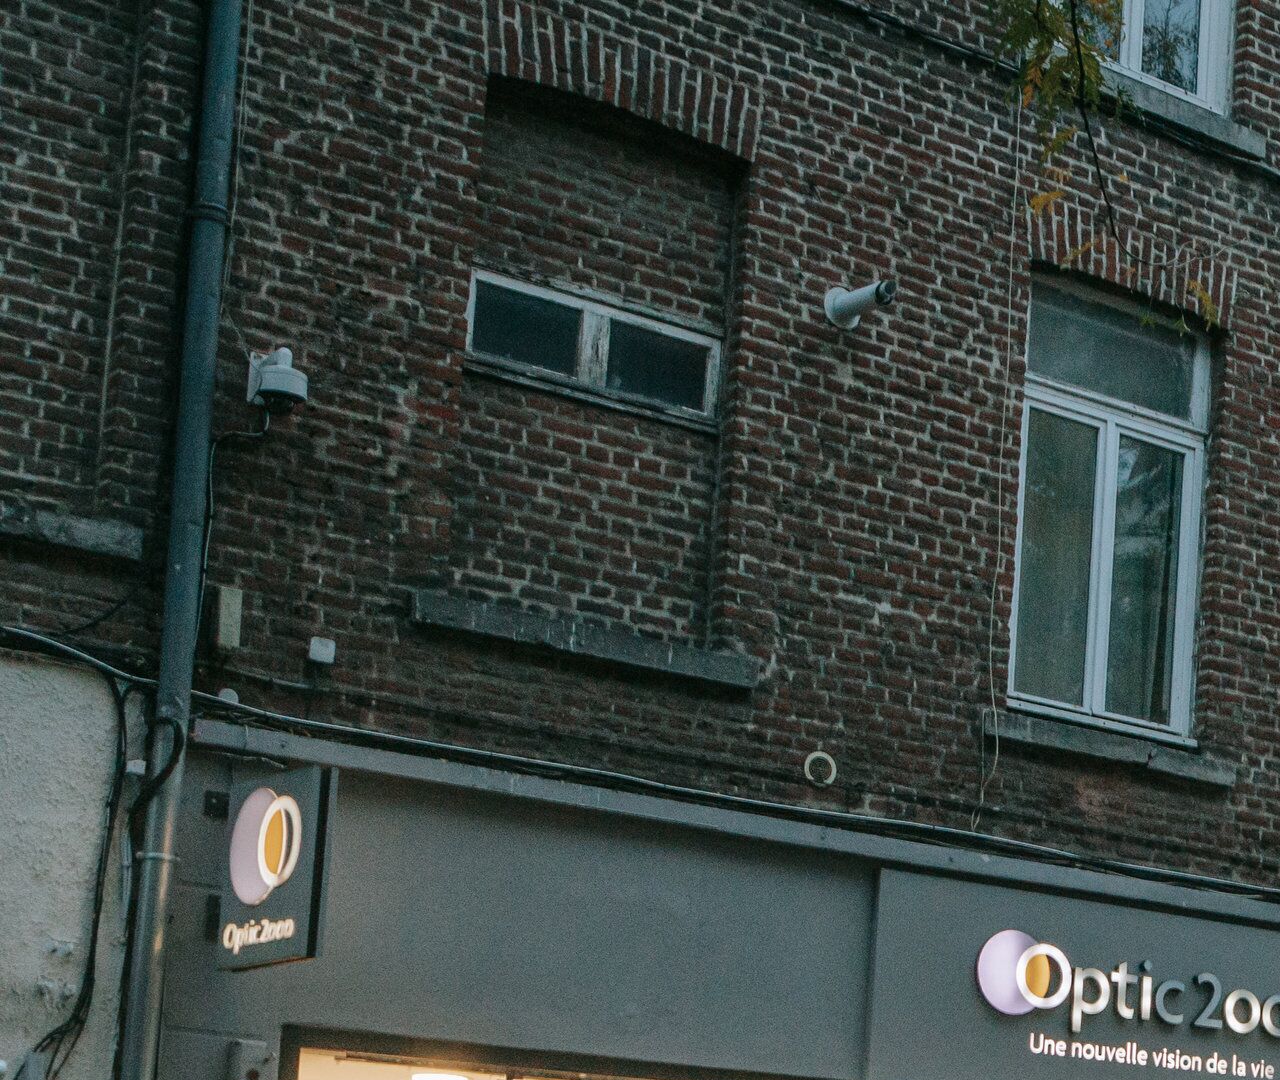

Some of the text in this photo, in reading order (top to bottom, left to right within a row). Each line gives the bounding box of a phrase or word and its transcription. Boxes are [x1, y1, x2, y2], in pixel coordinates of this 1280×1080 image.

[1016, 943, 1185, 1033] Optic
[1029, 1032, 1275, 1080] Une nouvelle vision de la vie
